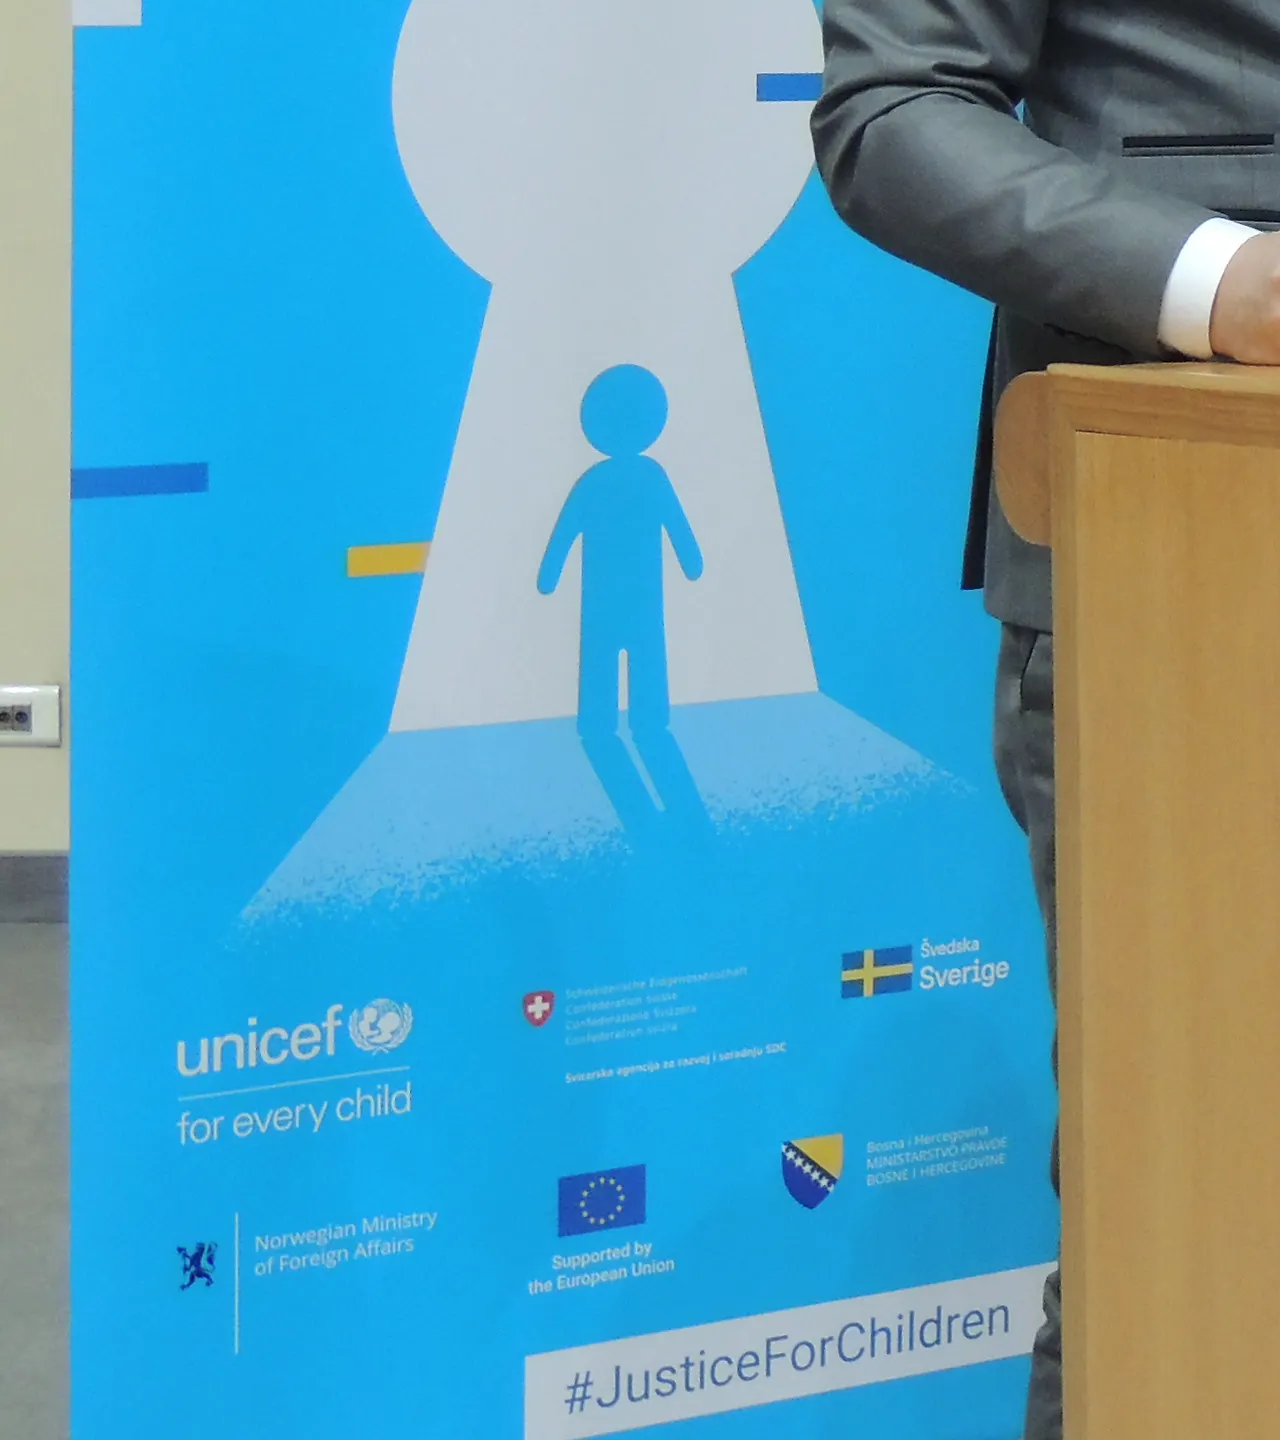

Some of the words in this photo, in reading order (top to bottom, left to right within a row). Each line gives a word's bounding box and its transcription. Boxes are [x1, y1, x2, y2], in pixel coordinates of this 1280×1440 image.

[920, 938, 979, 958] Švedska
[920, 958, 1009, 989] Sverige
[175, 1005, 345, 1076] unicef
[177, 1111, 222, 1145] for
[233, 1103, 328, 1135] every
[336, 1082, 413, 1122] child
[867, 1139, 904, 1153] Bosna
[867, 1147, 958, 1170] MINISTARSTVO
[961, 1137, 1008, 1153] PRAVDE
[867, 1169, 908, 1186] BOSNE
[920, 1153, 1006, 1176] HERCEGOVINE
[254, 1221, 356, 1256] Norwegian
[361, 1209, 438, 1236] Ministry
[253, 1256, 275, 1277] of
[279, 1248, 349, 1274] Foreign
[353, 1236, 414, 1262] Affairs
[552, 1244, 630, 1270] Supported
[634, 1241, 653, 1259] by
[528, 1279, 553, 1295] the
[556, 1268, 628, 1293] European
[631, 1257, 675, 1278] Union
[564, 1302, 1011, 1415] #JusticeForChildren
